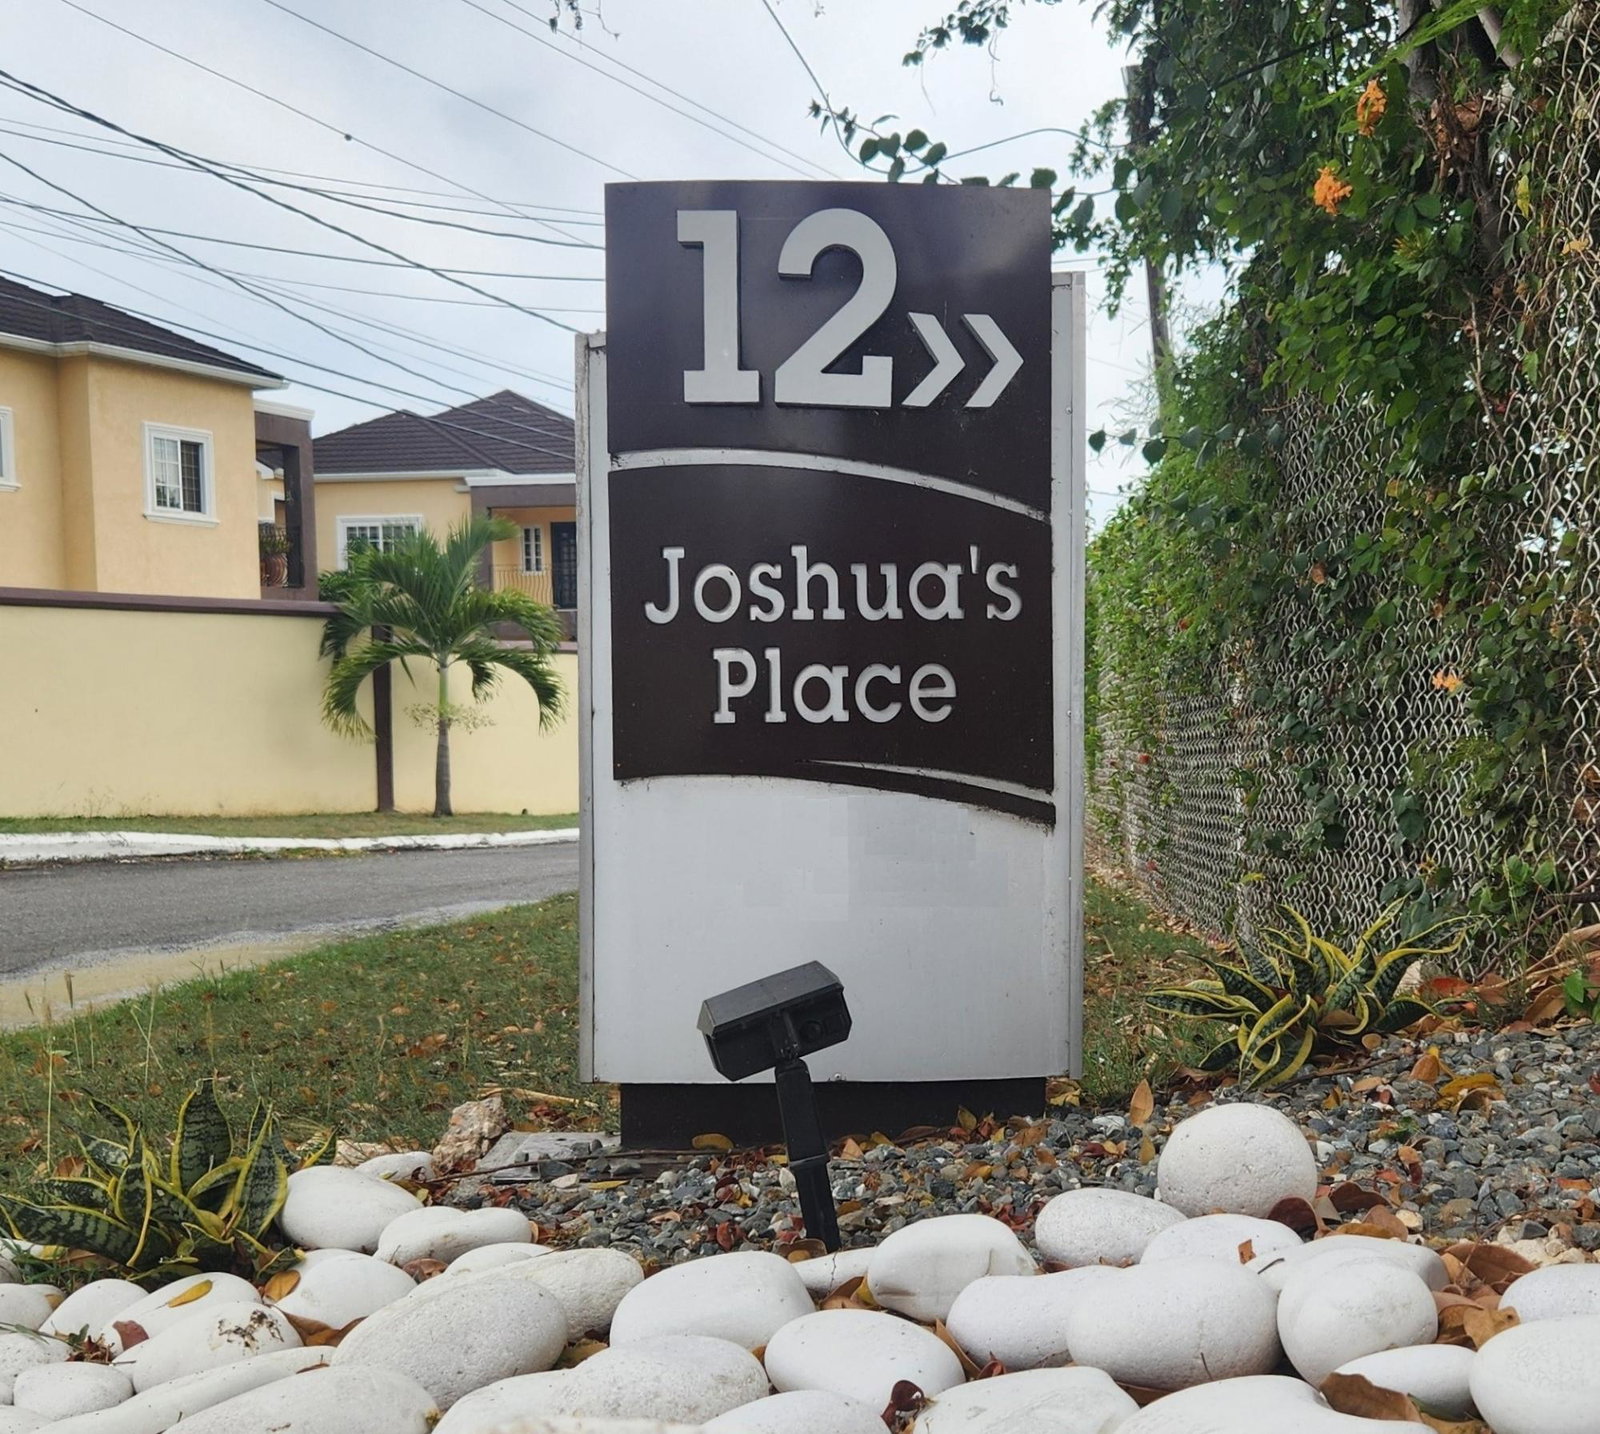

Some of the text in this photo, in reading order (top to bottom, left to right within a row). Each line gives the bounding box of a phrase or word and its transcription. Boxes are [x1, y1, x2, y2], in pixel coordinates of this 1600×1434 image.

[677, 208, 897, 408] 12
[644, 545, 1022, 624] Joshua's
[712, 647, 957, 724] Place
